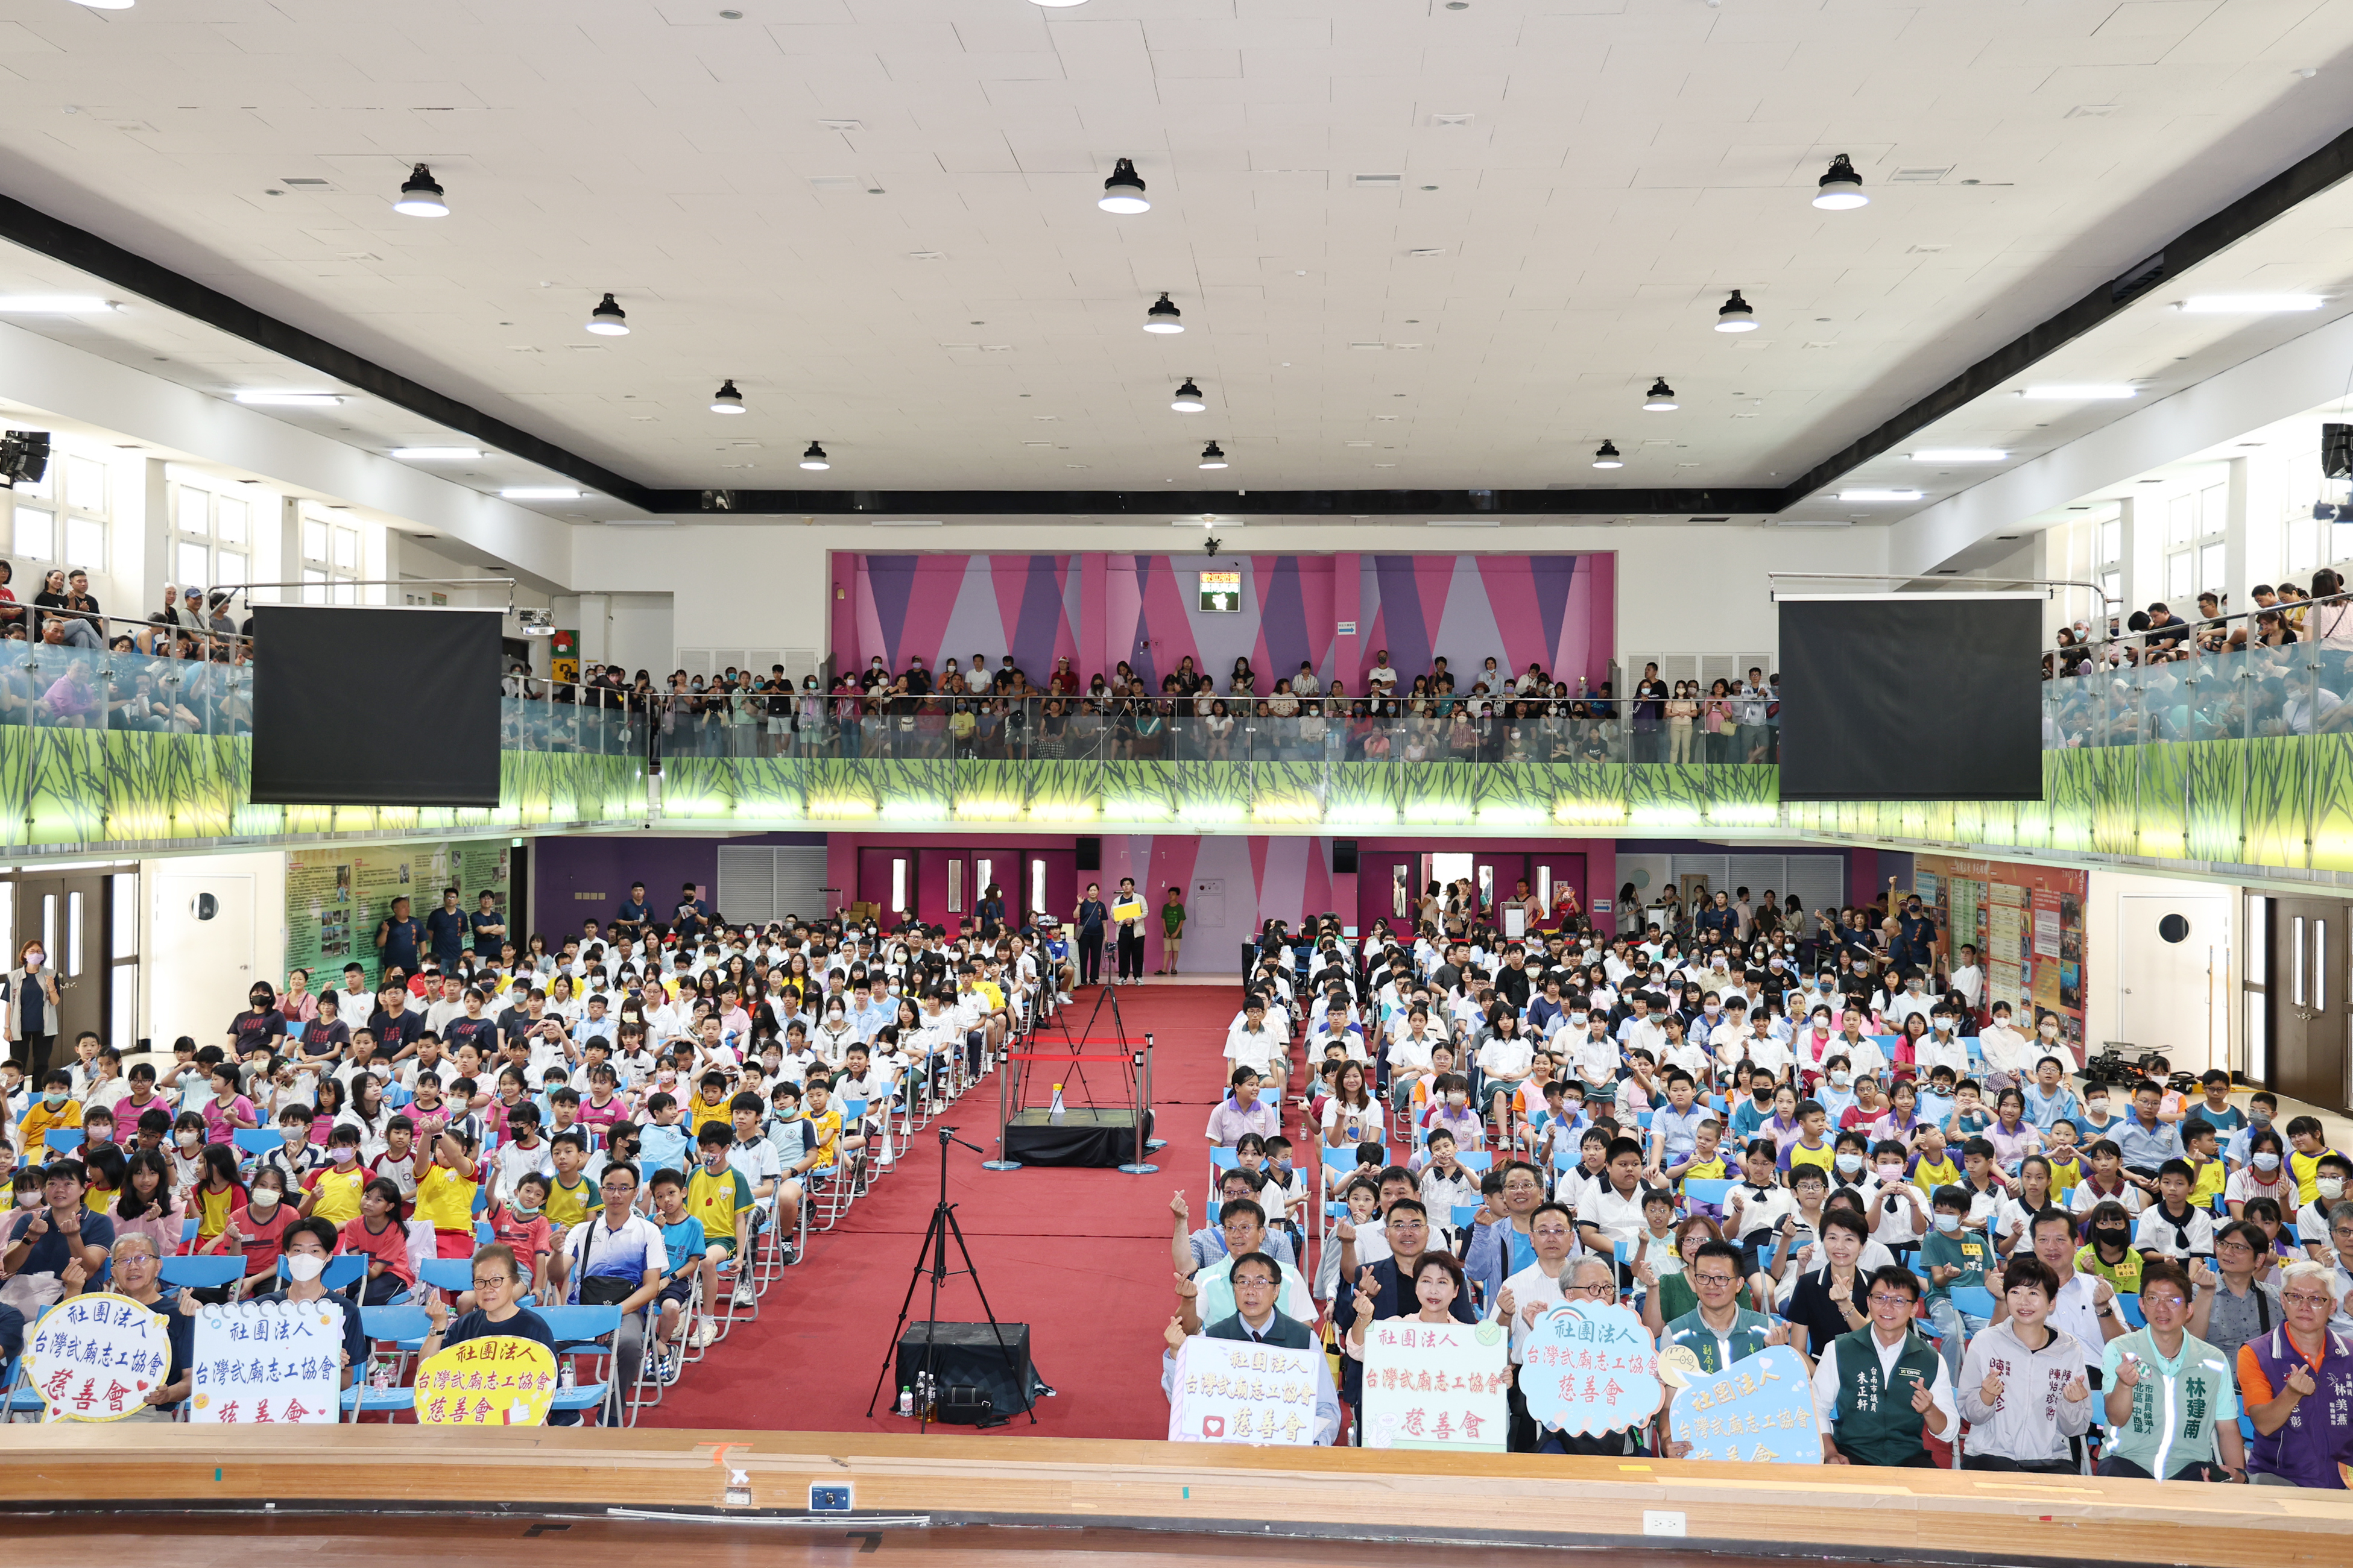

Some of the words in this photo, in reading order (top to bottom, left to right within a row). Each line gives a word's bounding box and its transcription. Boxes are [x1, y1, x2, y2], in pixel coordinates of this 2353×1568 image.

[68, 1301, 148, 1338] 社團法人
[230, 1319, 314, 1341] 社團法人
[1554, 1319, 1638, 1344] 社團法人
[35, 1332, 164, 1378] 台灣武廟志工協會
[455, 1340, 537, 1364] 社團法人
[1378, 1328, 1459, 1349] 社團法人
[195, 1355, 336, 1385] 台灣武廟志工協會
[1230, 1350, 1309, 1374] 社團法人
[1526, 1344, 1658, 1377] 台灣武廟志工協會
[1702, 1344, 1714, 1374] 副局長
[42, 1367, 132, 1411] 慈善會
[418, 1370, 552, 1392] 台灣武廟志工協會
[1184, 1371, 1316, 1406] 台灣武廟志工協會
[1365, 1367, 1503, 1395] 台灣武廟志工協會
[1558, 1375, 1625, 1407] 慈善會
[1691, 1368, 1781, 1413] 社團法人
[1857, 1371, 1868, 1412] 朱正軒
[1870, 1366, 1879, 1412] 台南市議員
[2045, 1368, 2061, 1404] 陳怡珍
[2345, 1372, 2353, 1396] 市議員
[426, 1396, 494, 1424] 慈善會
[2143, 1384, 2154, 1434] 市議員候選人
[2183, 1377, 2206, 1439] 林建南
[2334, 1383, 2348, 1426] 林美燕
[1231, 1406, 1307, 1442] 慈善會
[1401, 1407, 1486, 1440] 慈善會
[1678, 1406, 1811, 1440] 台灣武廟志工協會
